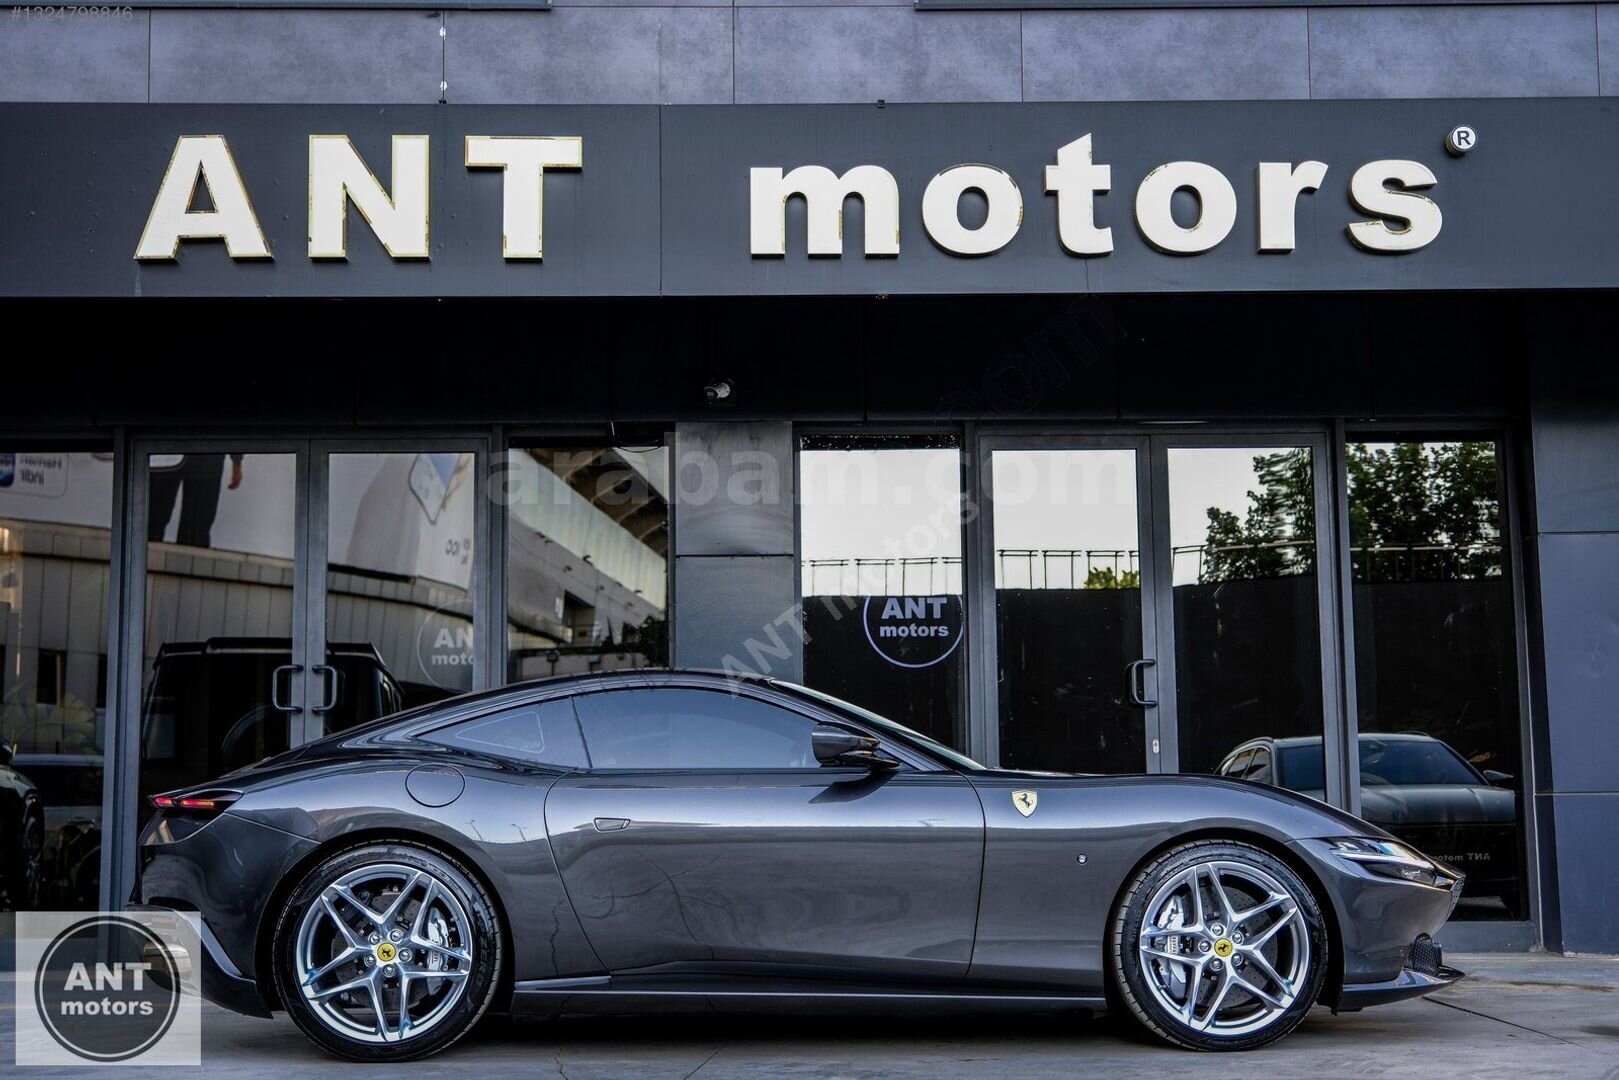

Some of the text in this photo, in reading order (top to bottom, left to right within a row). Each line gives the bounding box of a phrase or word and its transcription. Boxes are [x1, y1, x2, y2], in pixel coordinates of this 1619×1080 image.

[133, 134, 584, 261] ANT
[750, 132, 1443, 258] motors
[881, 597, 947, 619] ANT
[433, 627, 474, 648] AN
[880, 623, 949, 637] motors
[431, 653, 474, 665] moto
